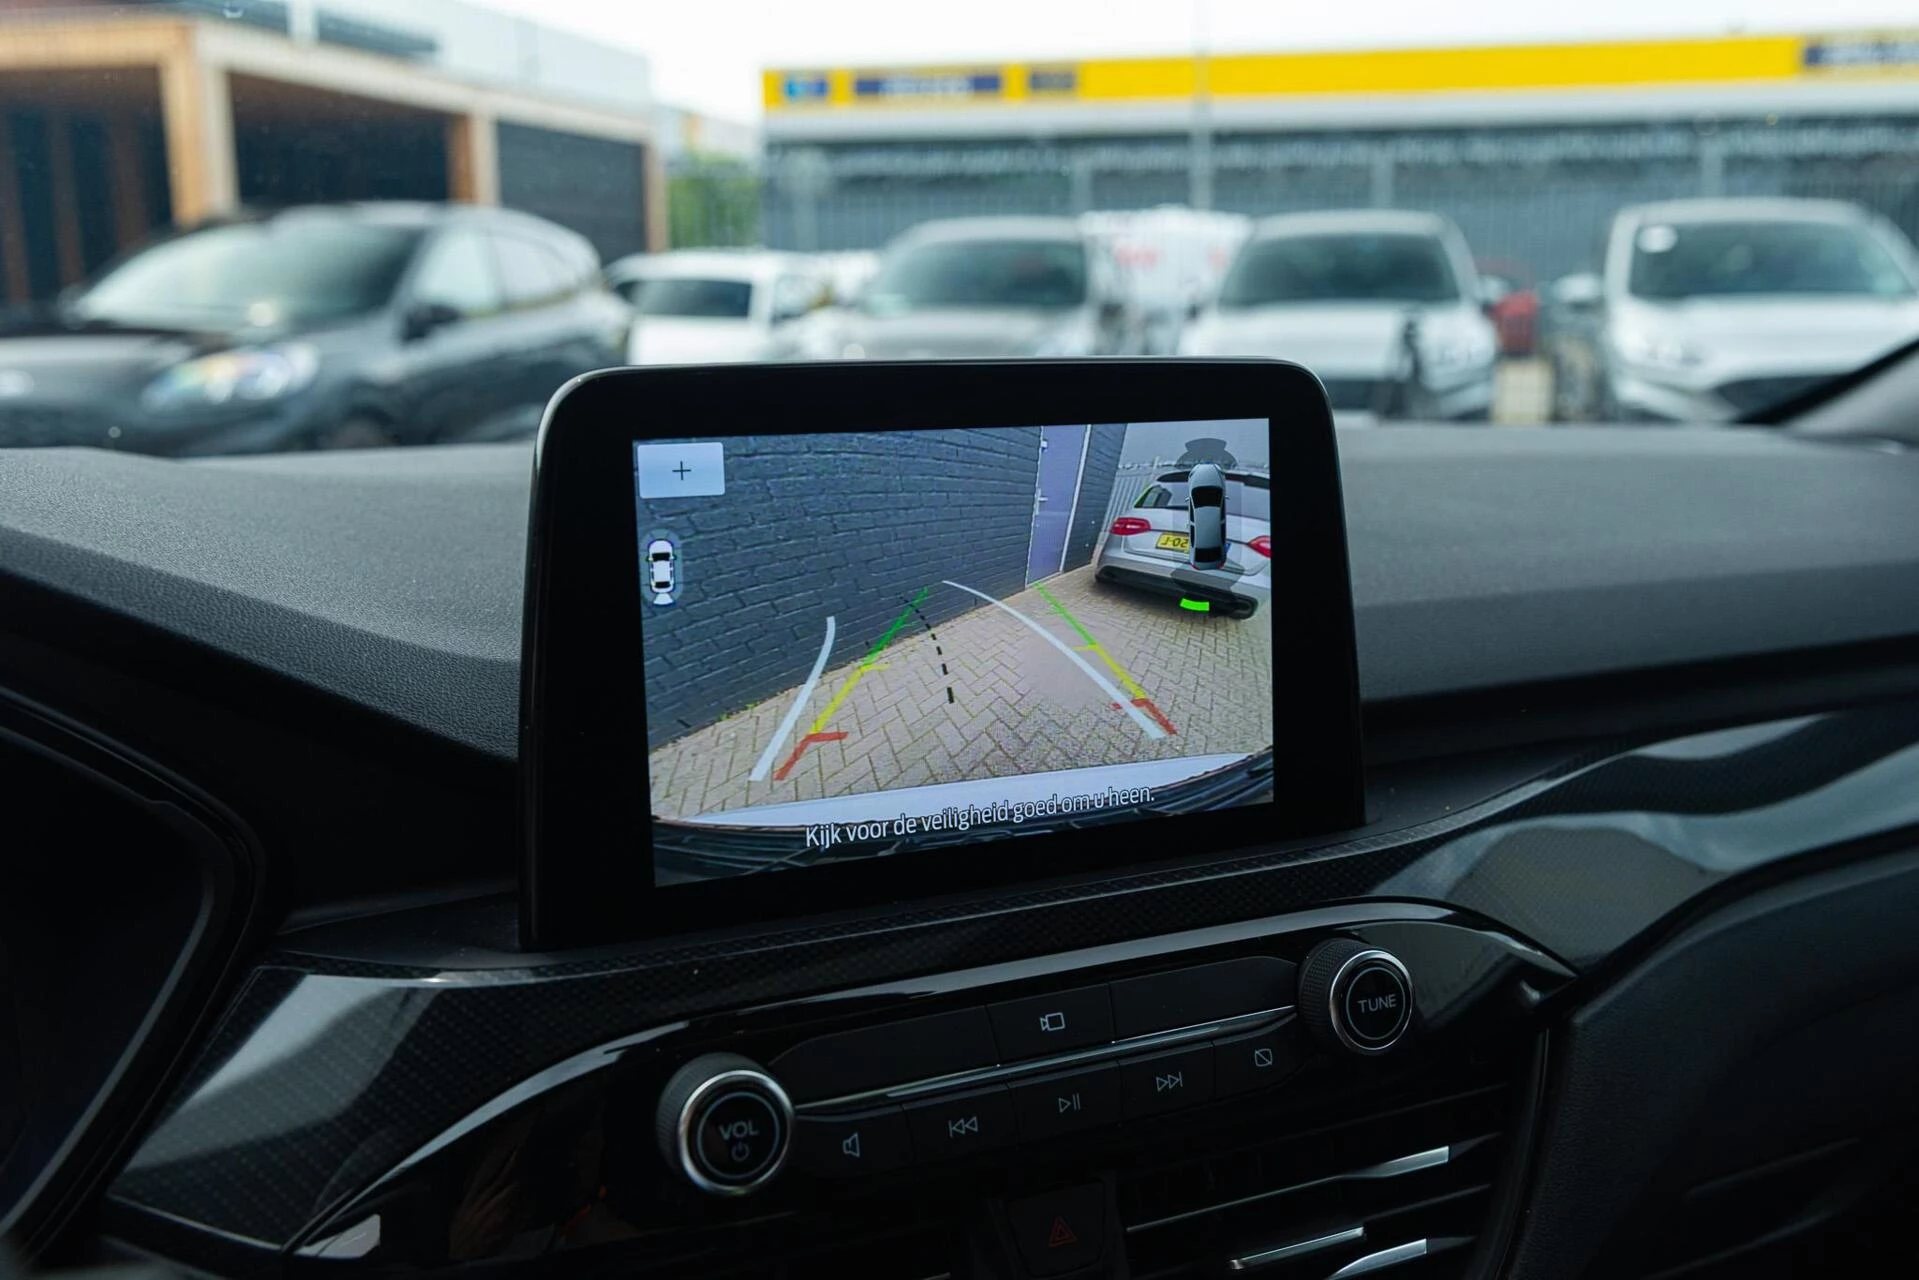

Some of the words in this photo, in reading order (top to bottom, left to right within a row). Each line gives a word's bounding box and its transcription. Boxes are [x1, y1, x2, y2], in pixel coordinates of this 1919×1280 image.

[806, 823, 842, 849] Kijk
[844, 821, 889, 842] voor
[893, 813, 917, 835] de
[921, 801, 1009, 831] veiligheid
[1013, 794, 1057, 823] goed
[1061, 793, 1090, 813] om
[1094, 793, 1104, 809] u
[1108, 786, 1155, 807] heen.
[1357, 993, 1398, 1014] TUNE
[718, 1120, 760, 1140] VOL
